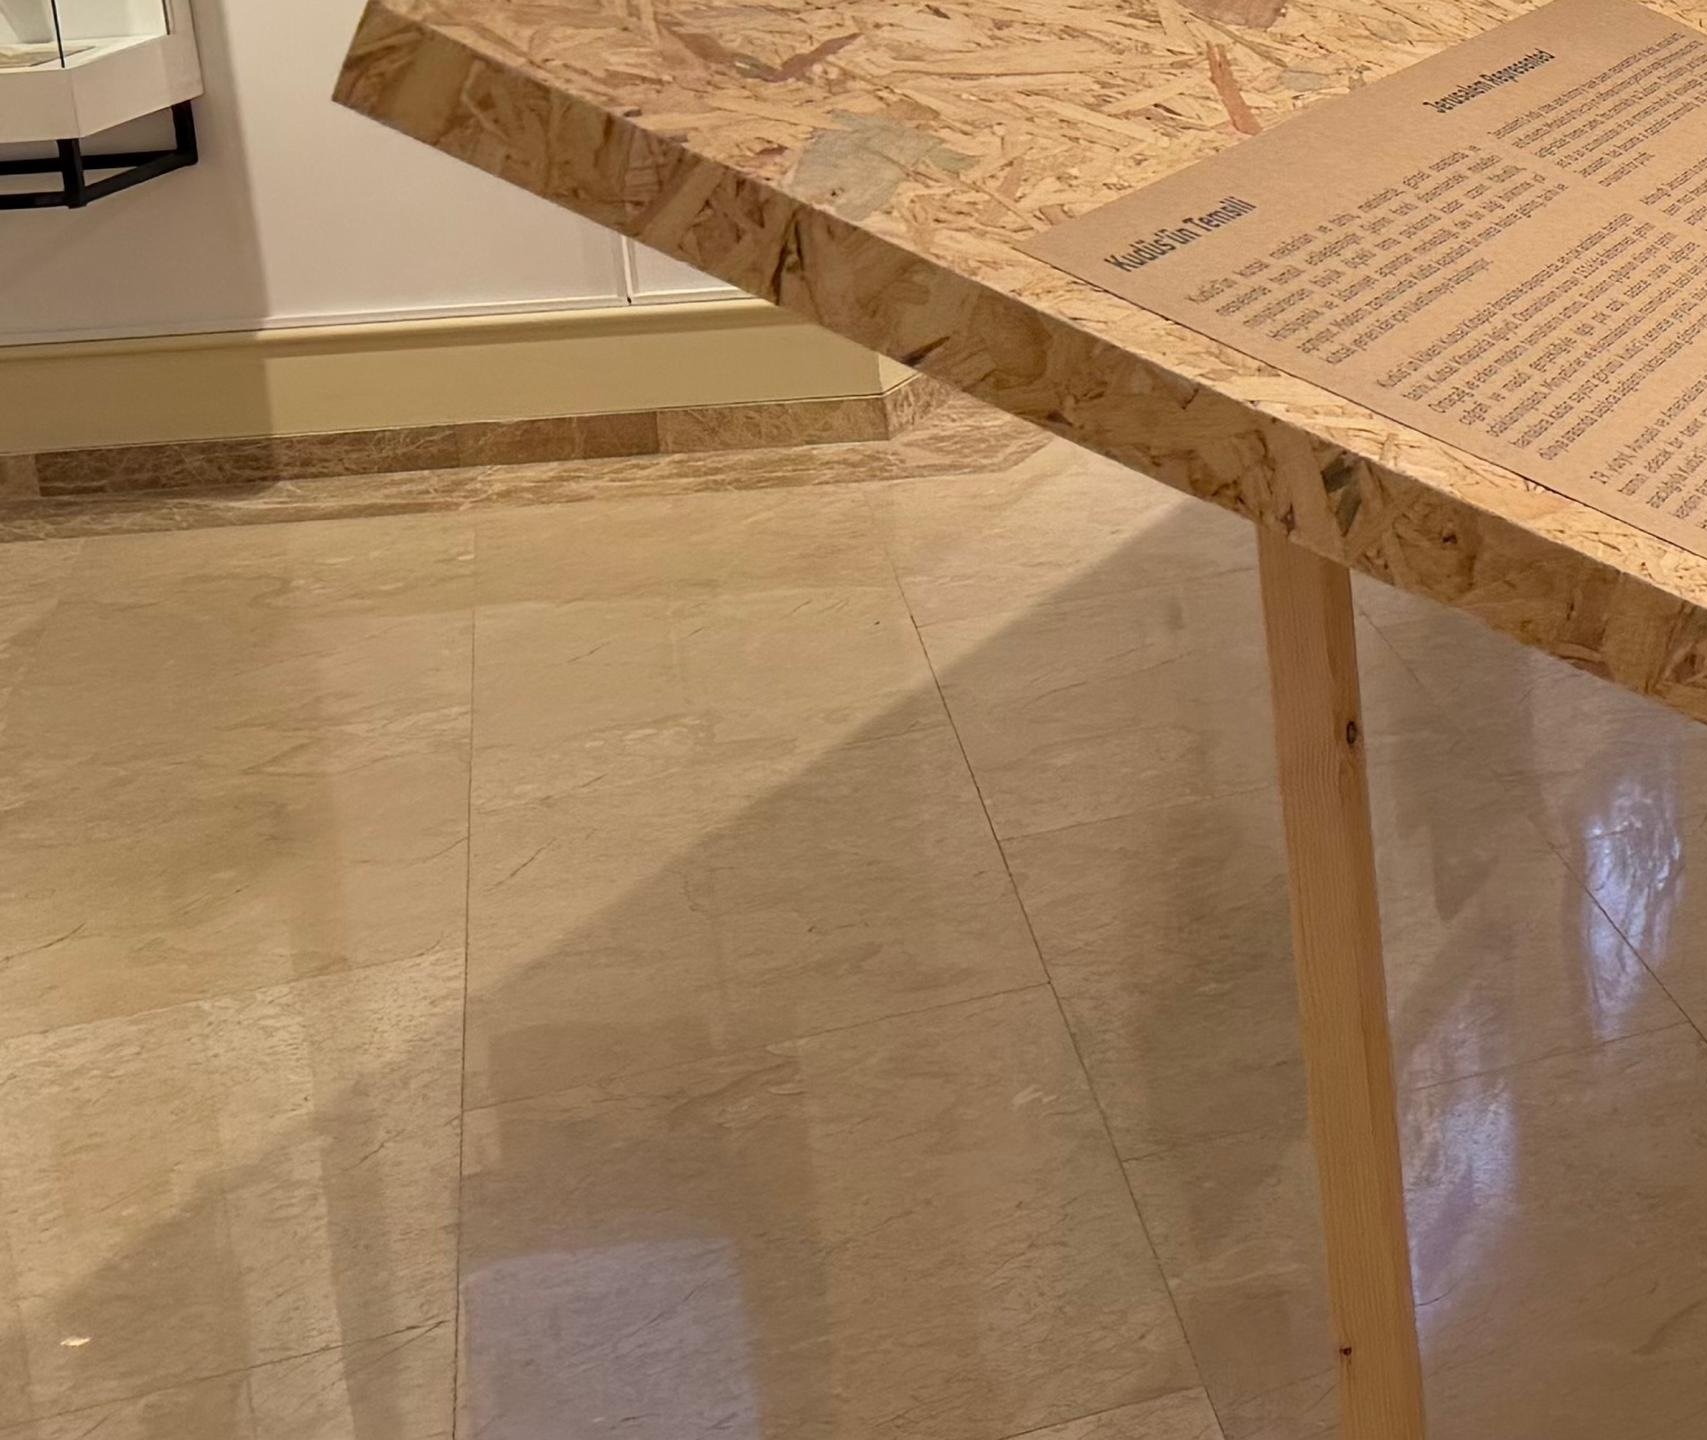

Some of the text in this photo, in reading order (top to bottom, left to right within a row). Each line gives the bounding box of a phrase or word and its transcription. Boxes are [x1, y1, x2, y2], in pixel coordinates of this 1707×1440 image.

[1423, 48, 1555, 114] Jerusalem Represented
[1105, 196, 1256, 272] Kudüs'ün Temsili
